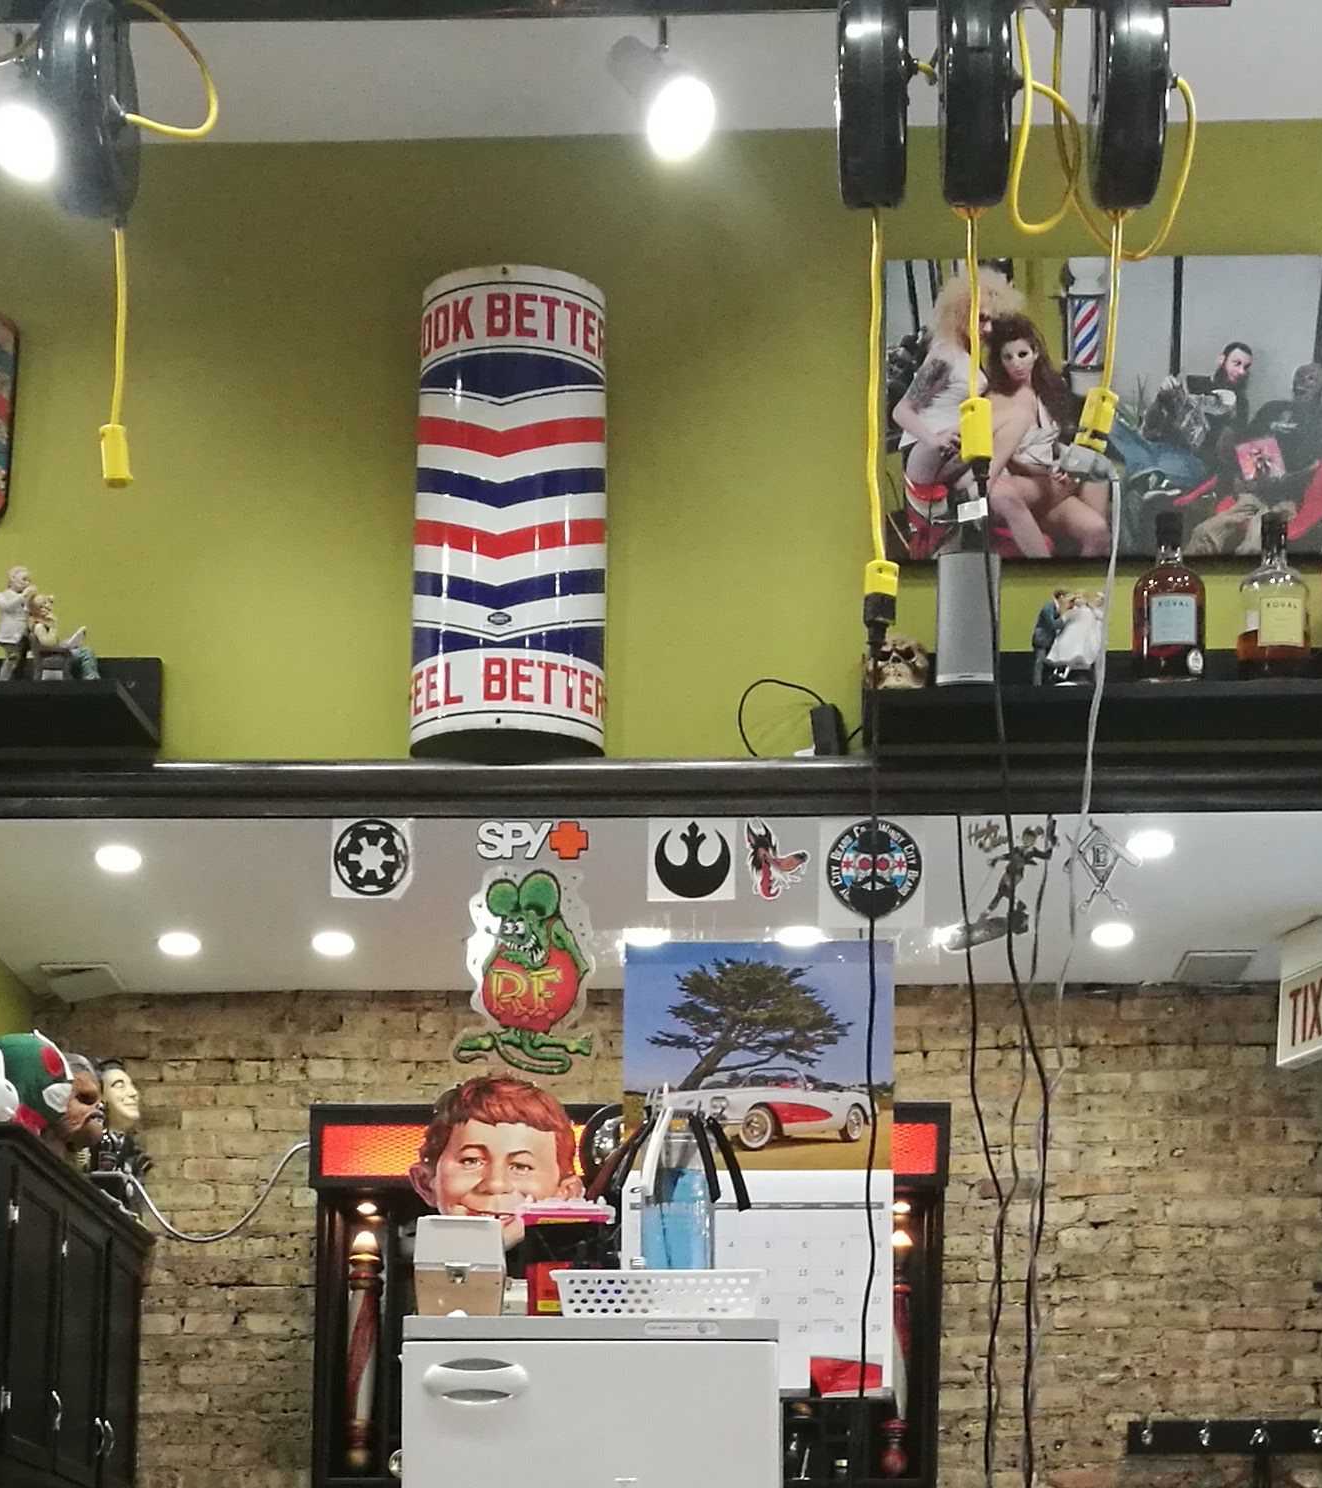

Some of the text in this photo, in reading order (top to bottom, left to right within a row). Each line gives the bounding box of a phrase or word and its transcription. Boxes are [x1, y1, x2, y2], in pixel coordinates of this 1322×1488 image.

[421, 296, 474, 358] OOK
[412, 662, 463, 716] EEL
[830, 835, 853, 860] BEARD
[903, 841, 917, 865] CITY
